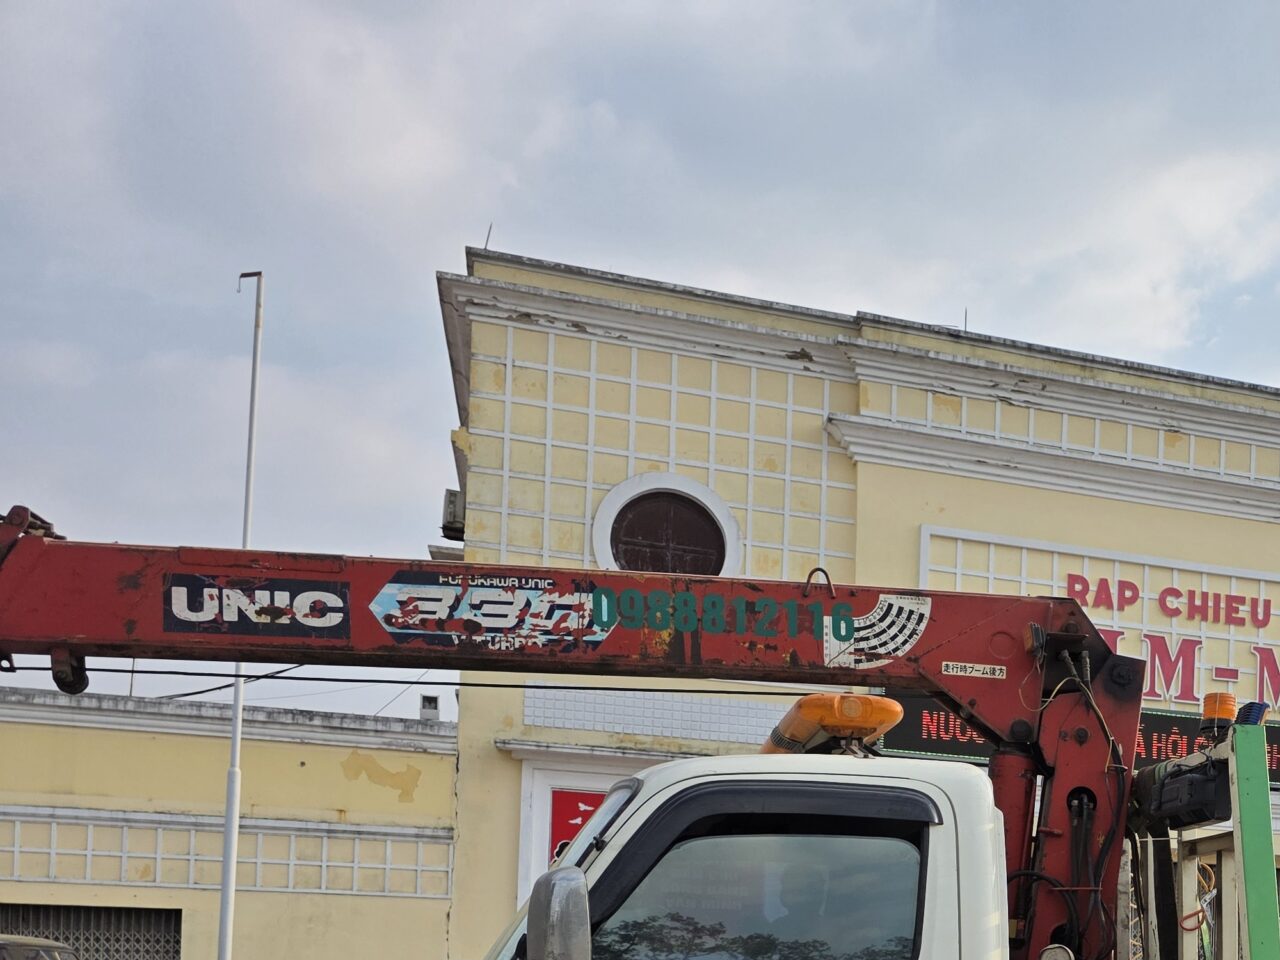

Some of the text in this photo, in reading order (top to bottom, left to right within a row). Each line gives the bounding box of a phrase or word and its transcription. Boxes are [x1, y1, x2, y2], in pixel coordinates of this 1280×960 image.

[171, 586, 345, 628] UNIC
[592, 587, 855, 642] 0988812116
[1066, 573, 1139, 611] RAP
[1157, 586, 1271, 629] CHIEU
[942, 662, 1007, 678] 走行時ブーム後方
